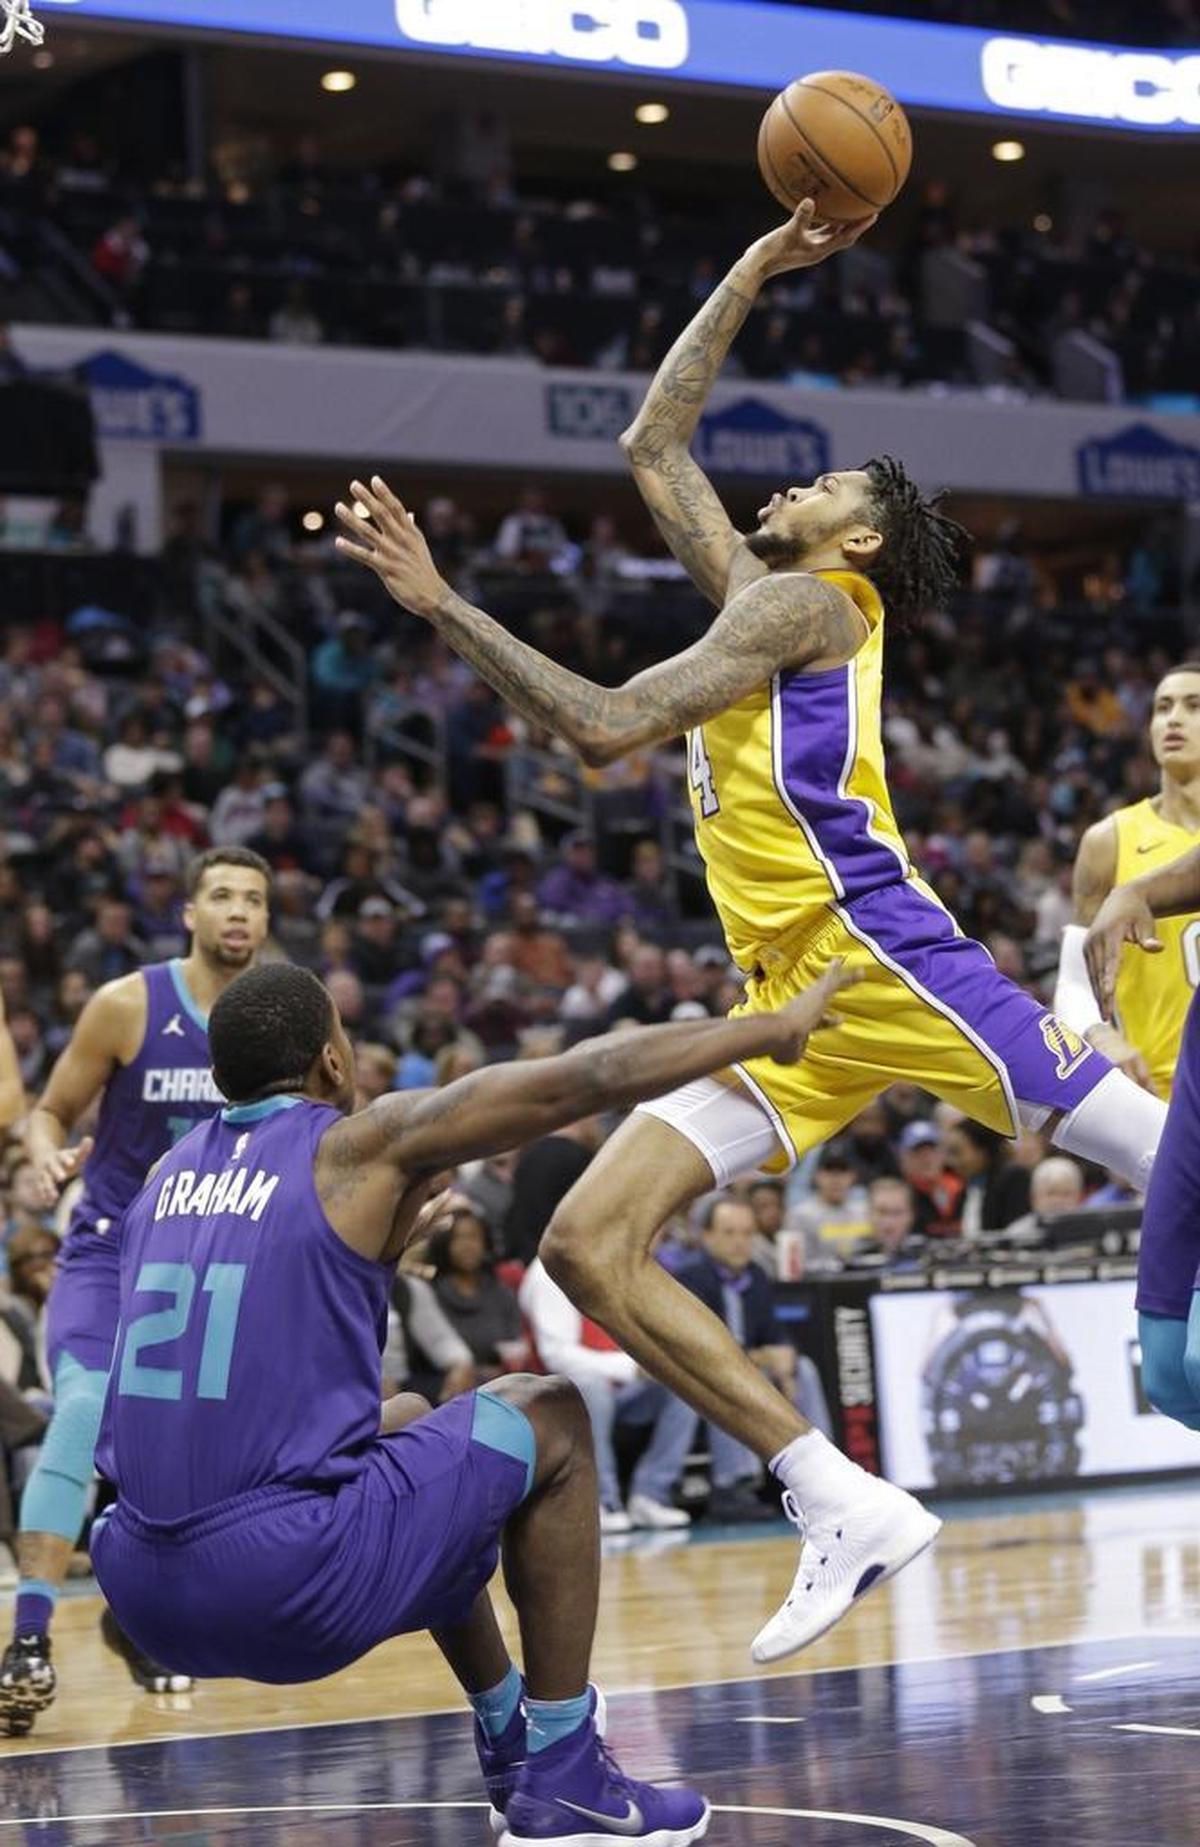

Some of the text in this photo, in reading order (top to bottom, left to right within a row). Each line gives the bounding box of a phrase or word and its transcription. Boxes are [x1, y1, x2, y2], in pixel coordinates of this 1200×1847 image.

[154, 1168, 280, 1222] GRAHAM
[118, 1262, 248, 1401] 21
[834, 1306, 873, 1407] SECURITY
